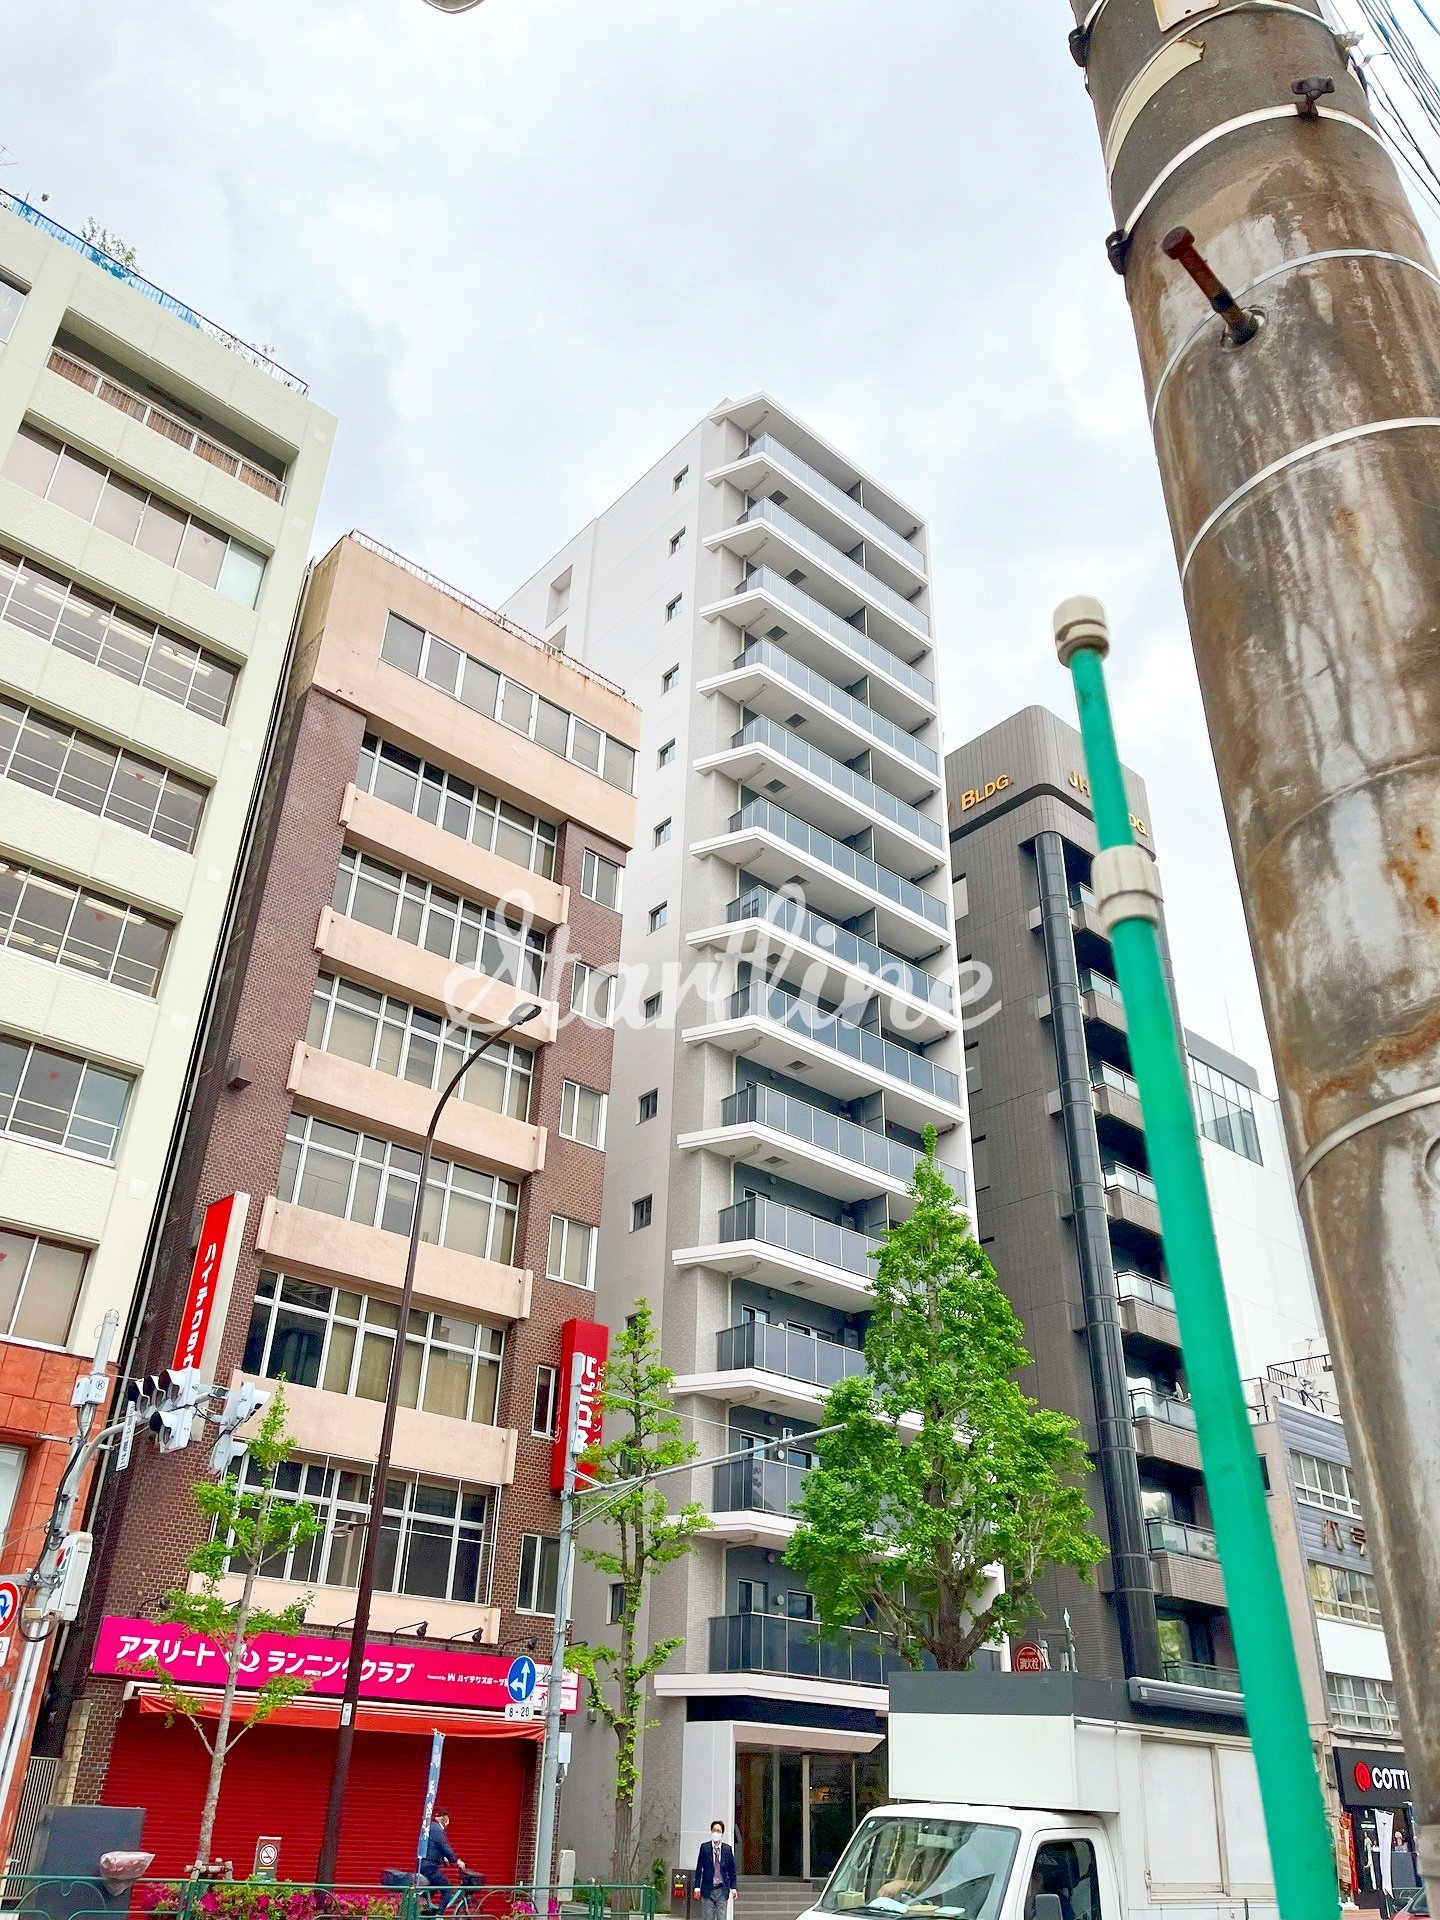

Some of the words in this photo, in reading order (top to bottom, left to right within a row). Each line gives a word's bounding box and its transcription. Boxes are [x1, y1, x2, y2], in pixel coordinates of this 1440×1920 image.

[116, 1636, 216, 1667] アスリート
